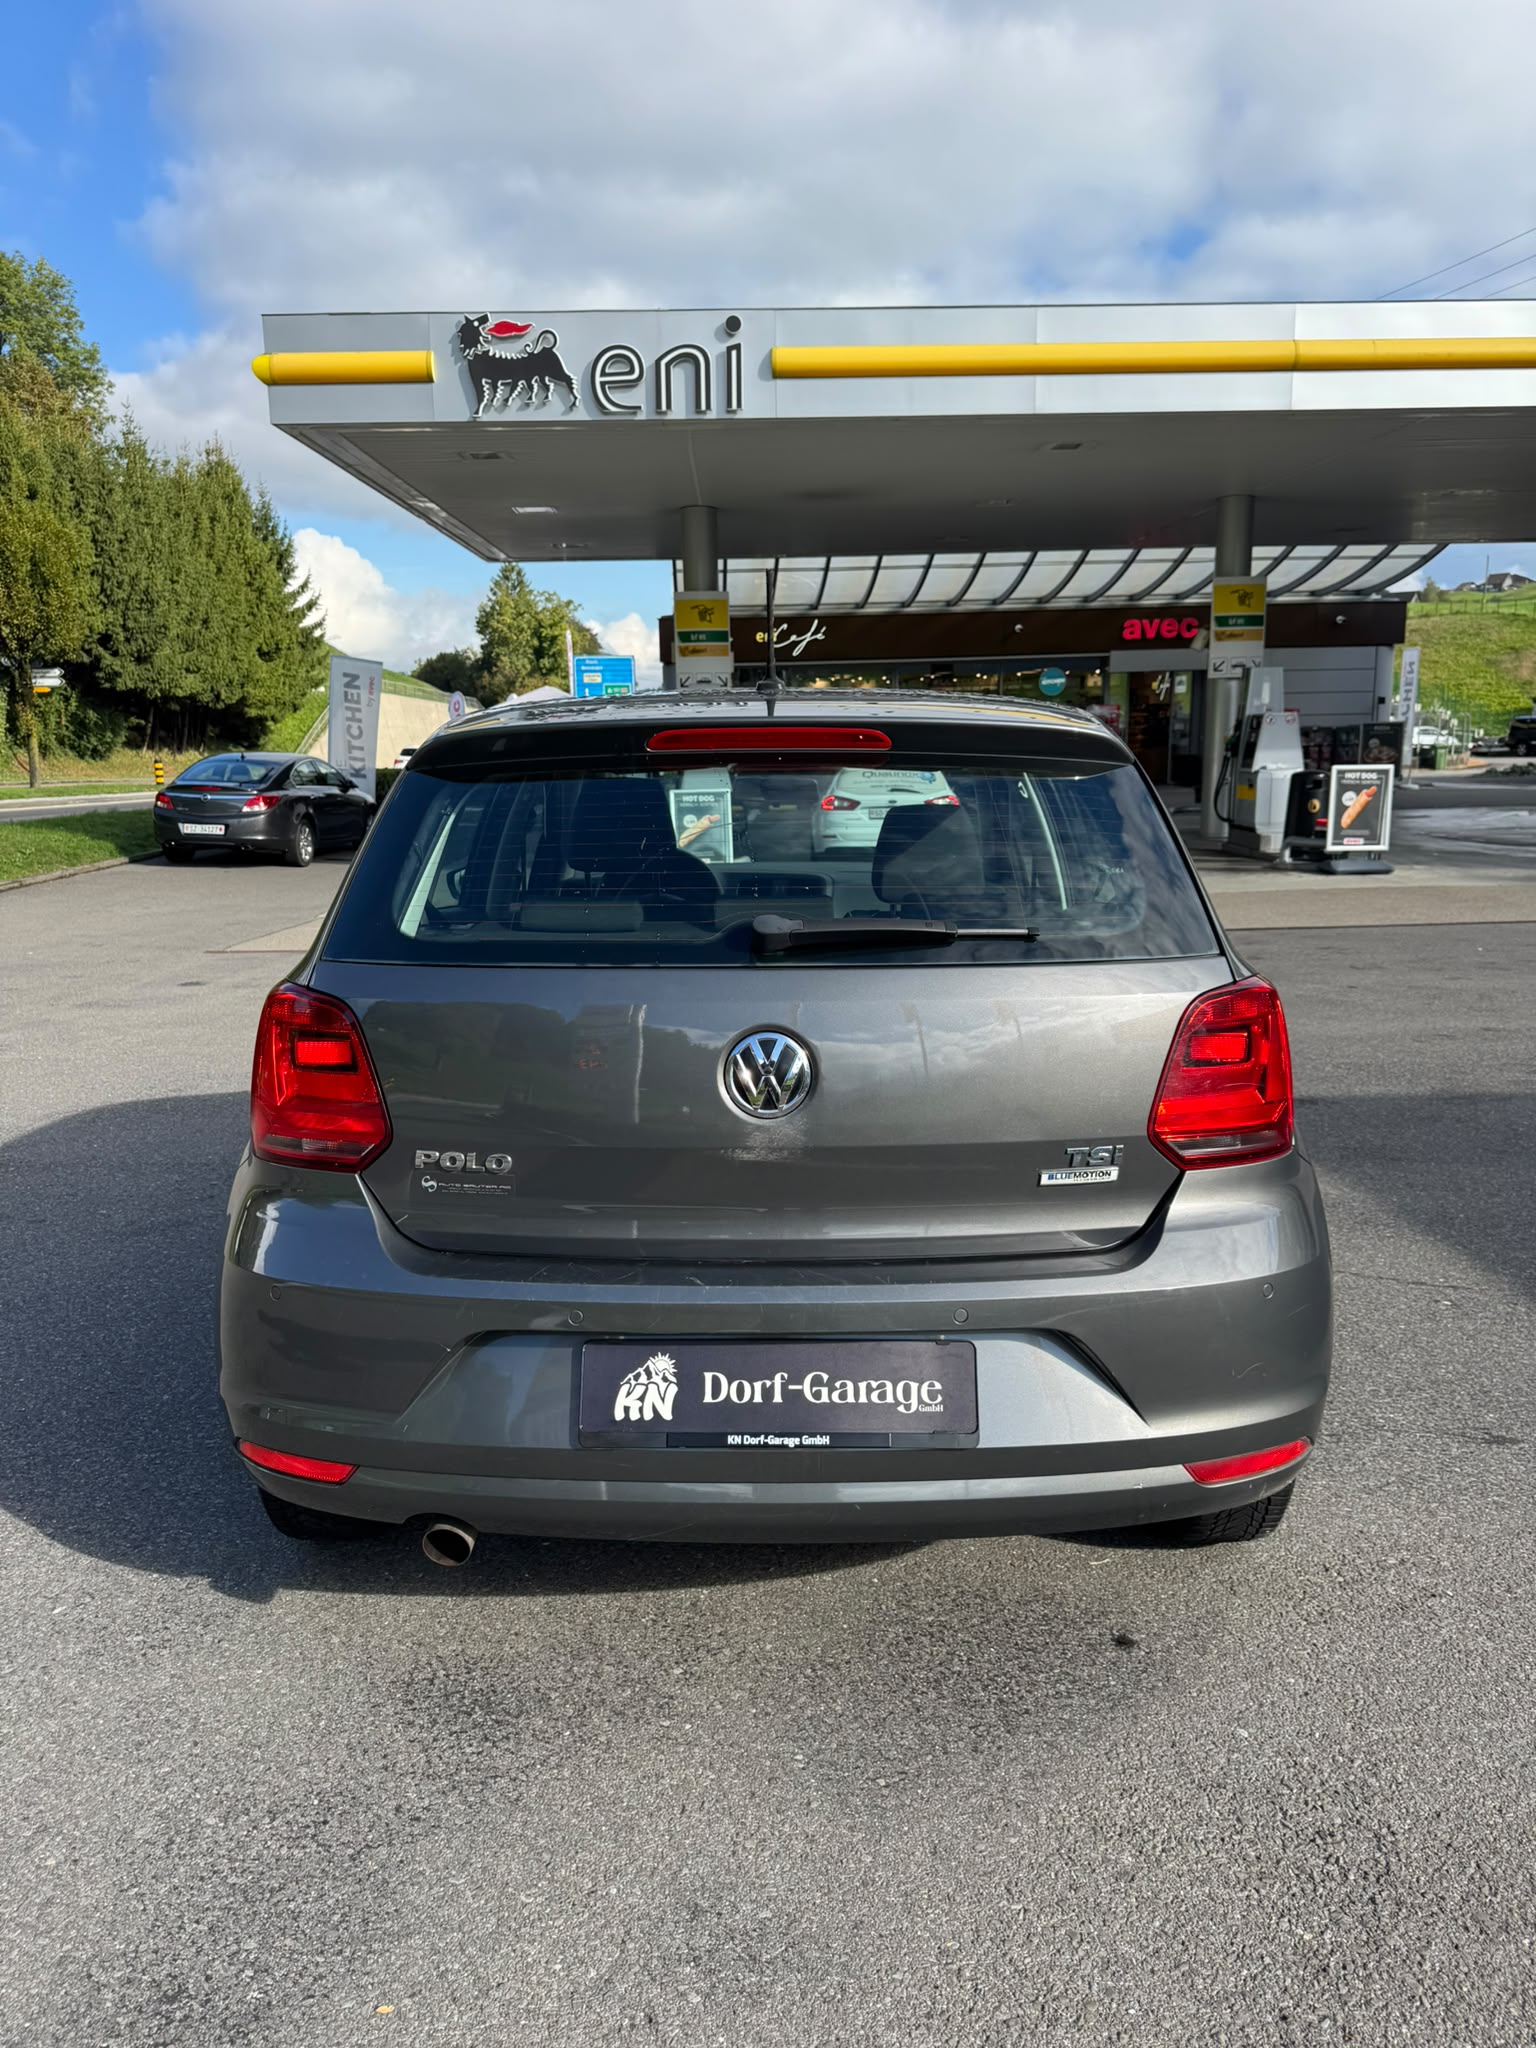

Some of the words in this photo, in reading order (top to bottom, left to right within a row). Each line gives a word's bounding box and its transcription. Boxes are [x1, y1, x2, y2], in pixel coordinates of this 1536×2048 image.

[590, 314, 742, 414] eni
[1122, 617, 1199, 640] avec
[342, 671, 367, 779] KITCHEN
[414, 1149, 513, 1175] POLO
[1047, 1170, 1112, 1181] BLUEMOTION
[614, 1381, 679, 1422] KN
[703, 1371, 943, 1414] Dorf-Garage
[918, 1404, 944, 1413] GmbH
[727, 1434, 742, 1446] KN
[743, 1434, 801, 1448] Dorf-Garage
[802, 1434, 831, 1446] GmbH
